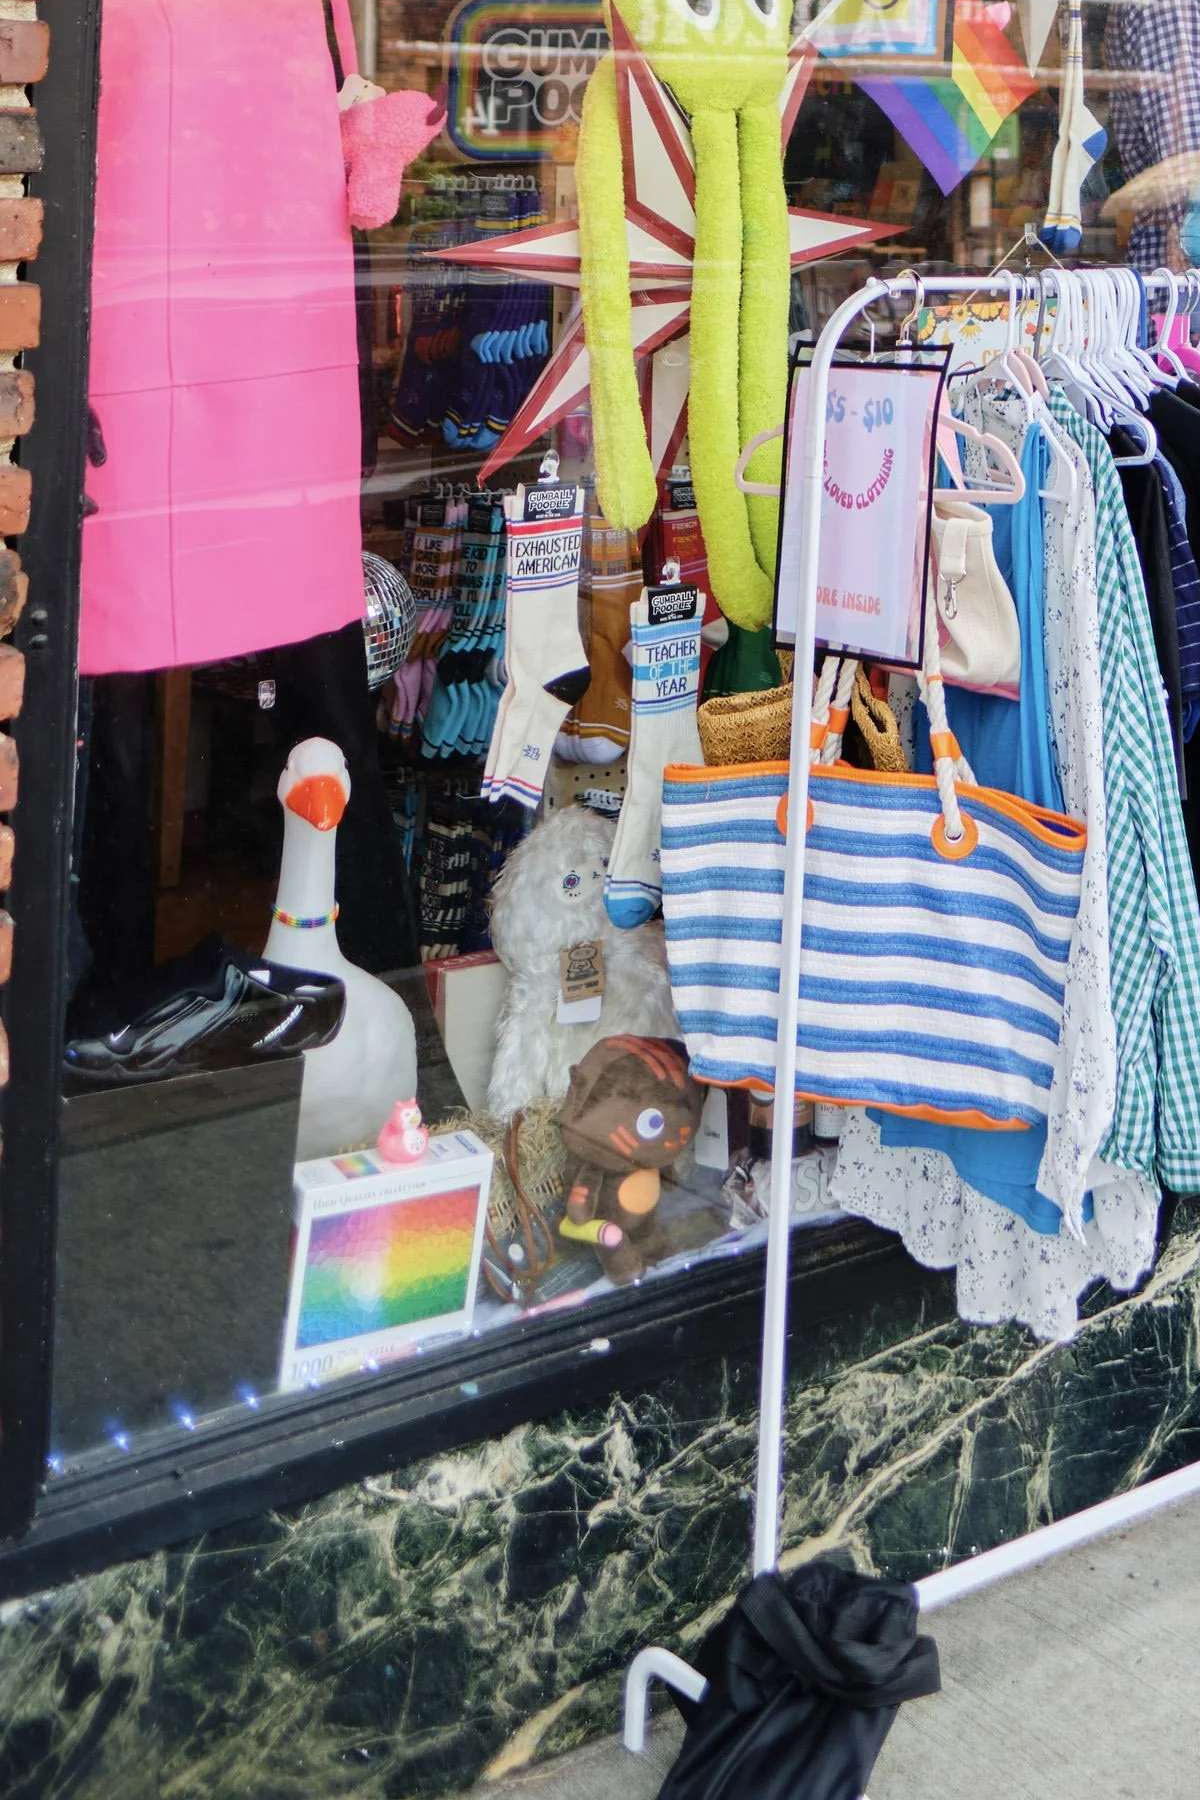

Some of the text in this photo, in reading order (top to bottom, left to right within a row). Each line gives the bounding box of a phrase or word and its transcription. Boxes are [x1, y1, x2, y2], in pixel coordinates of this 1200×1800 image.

[862, 397, 894, 433] $10
[855, 447, 895, 510] CLOTHING
[528, 489, 573, 504] GUMBALL
[528, 499, 571, 513] POODLE
[515, 534, 582, 558] EXHAUSTED
[517, 551, 579, 576] AMERICAN
[652, 590, 694, 607] GUMBALL
[652, 602, 691, 616] POODLE
[645, 639, 697, 664] TEACHER
[649, 659, 693, 680] OF THE
[656, 676, 688, 698] YEAR
[290, 1354, 334, 1382] 1000
